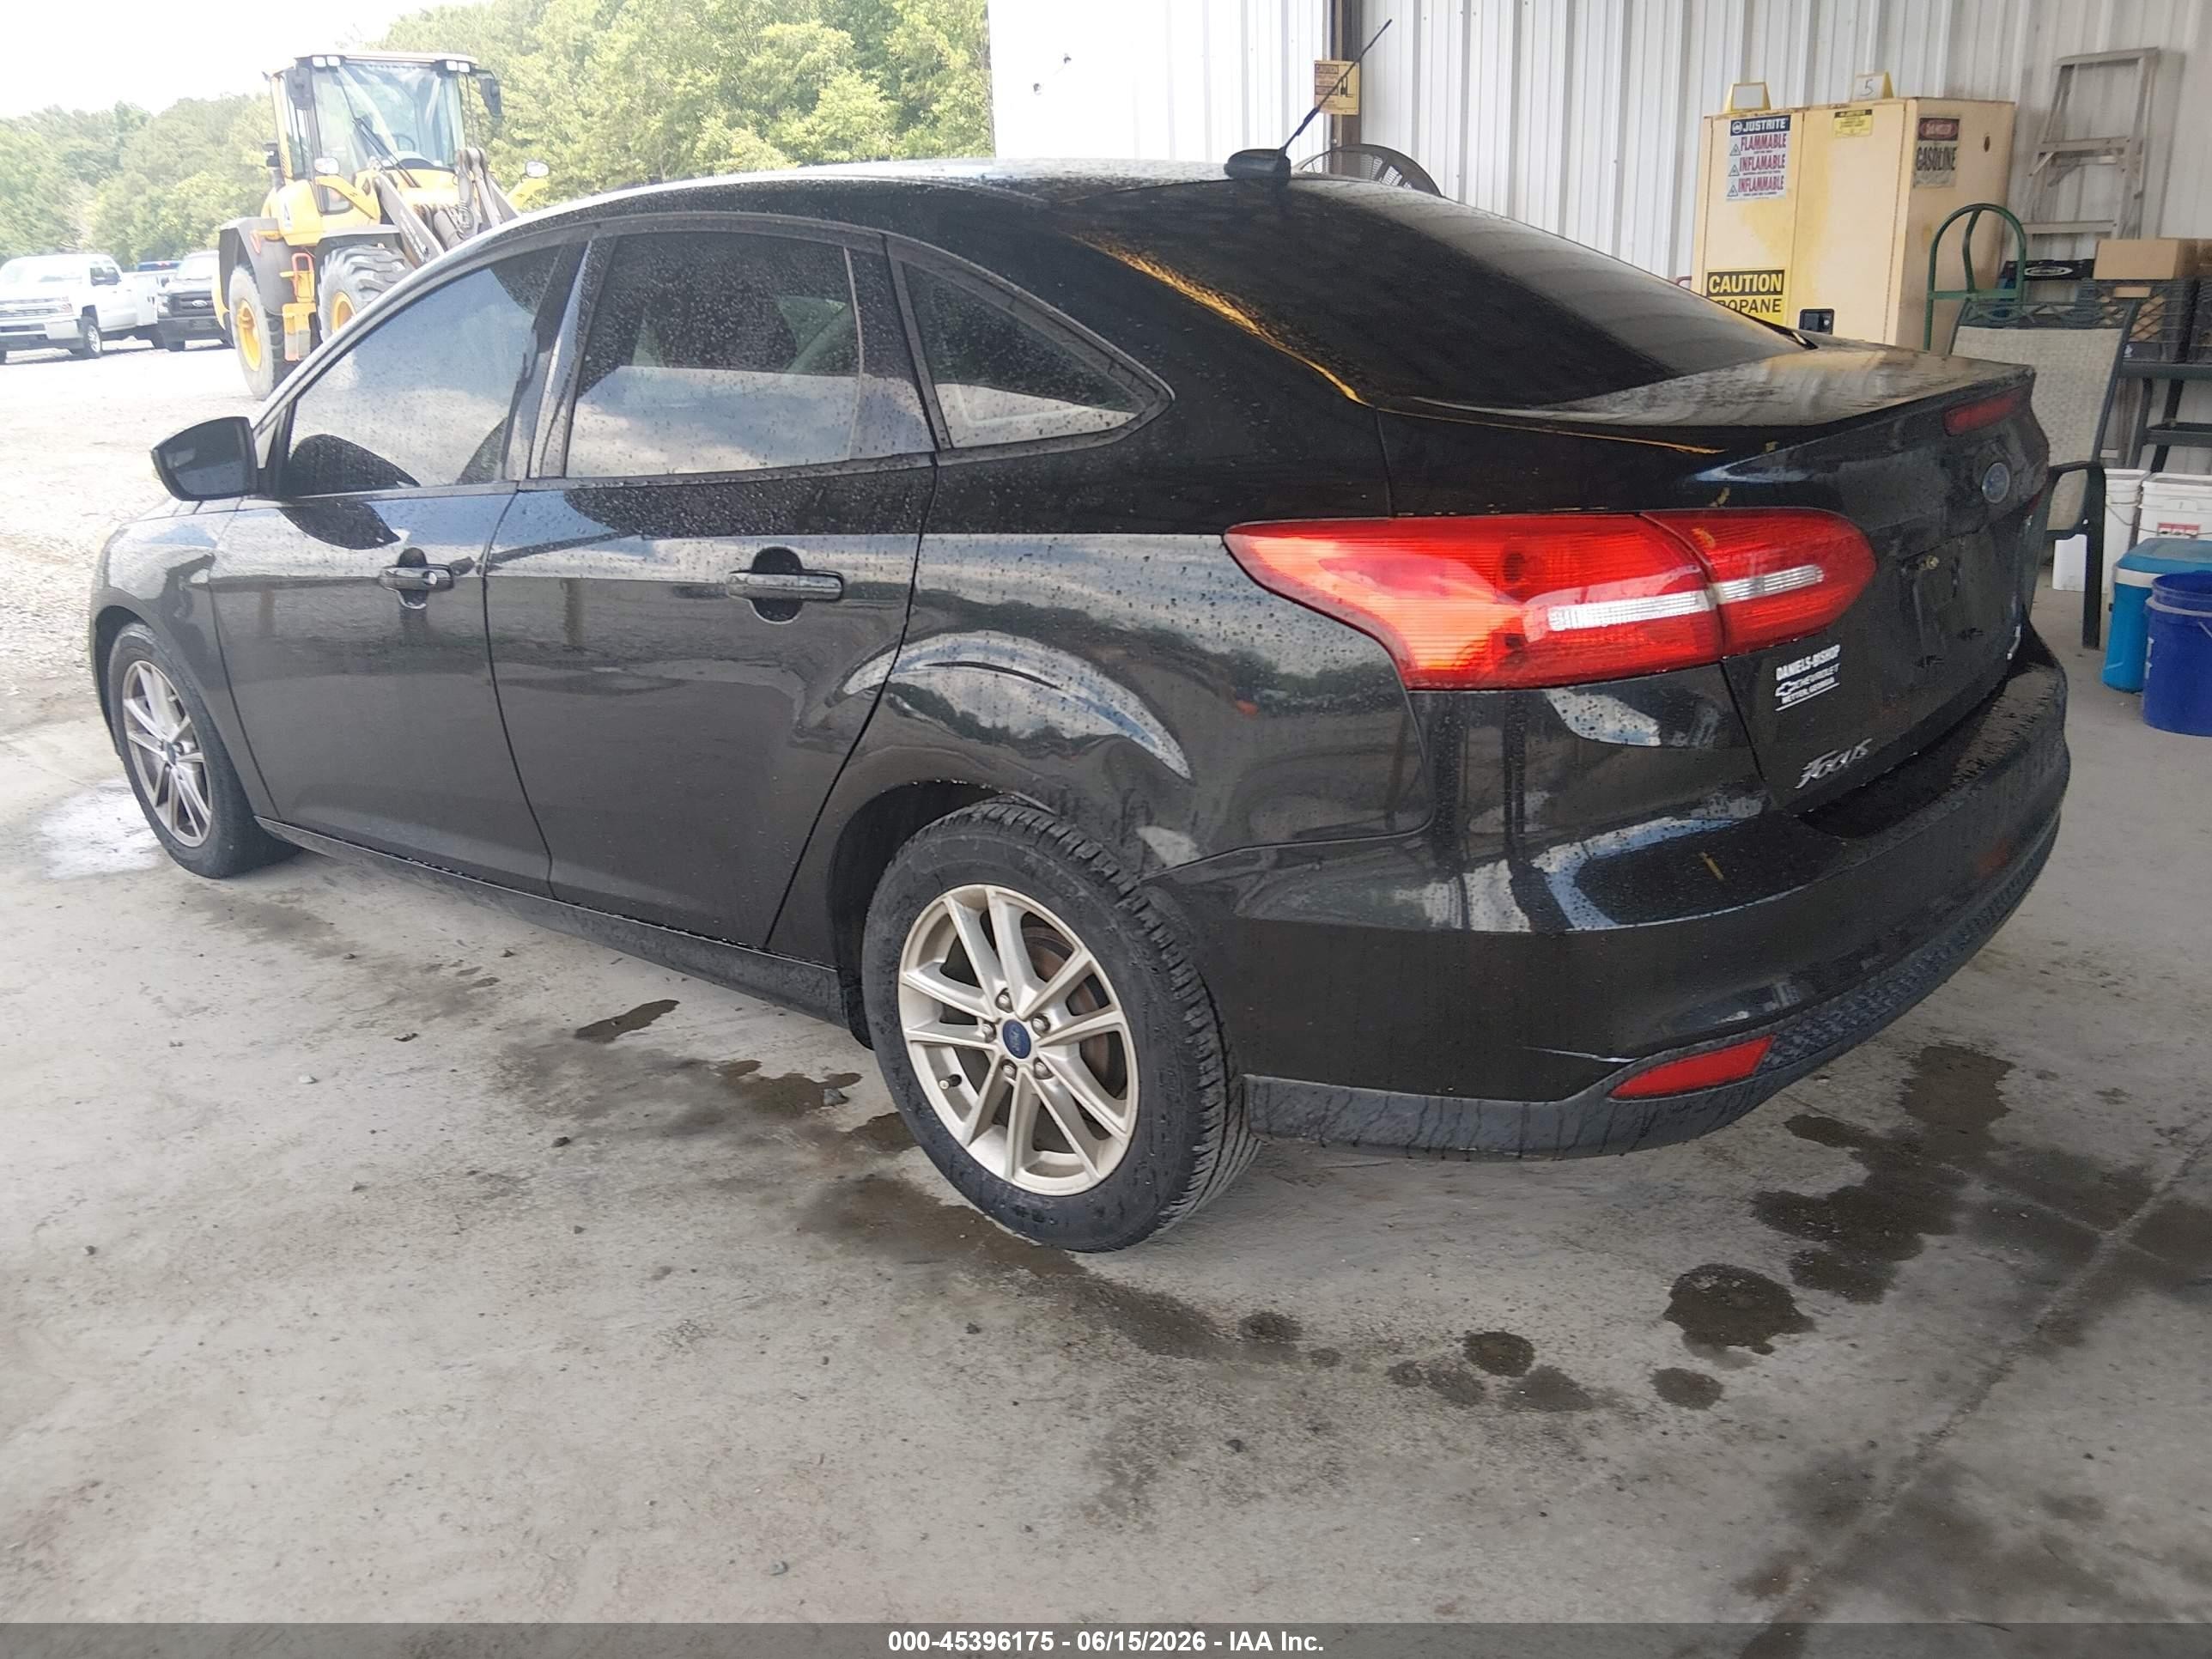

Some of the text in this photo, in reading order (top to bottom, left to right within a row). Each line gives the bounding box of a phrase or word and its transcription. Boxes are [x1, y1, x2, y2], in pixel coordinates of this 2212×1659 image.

[1860, 78, 1874, 97] 5
[1743, 118, 1787, 132] JUSTRITE
[1741, 133, 1787, 151] FLAMMABLE
[1740, 154, 1785, 172] INFLAMABLE
[1917, 146, 1958, 171] GASOLINE
[1738, 175, 1784, 192] INFLAMMABLE
[1709, 273, 1783, 293] CAUTION
[1717, 298, 1783, 313] OPANE
